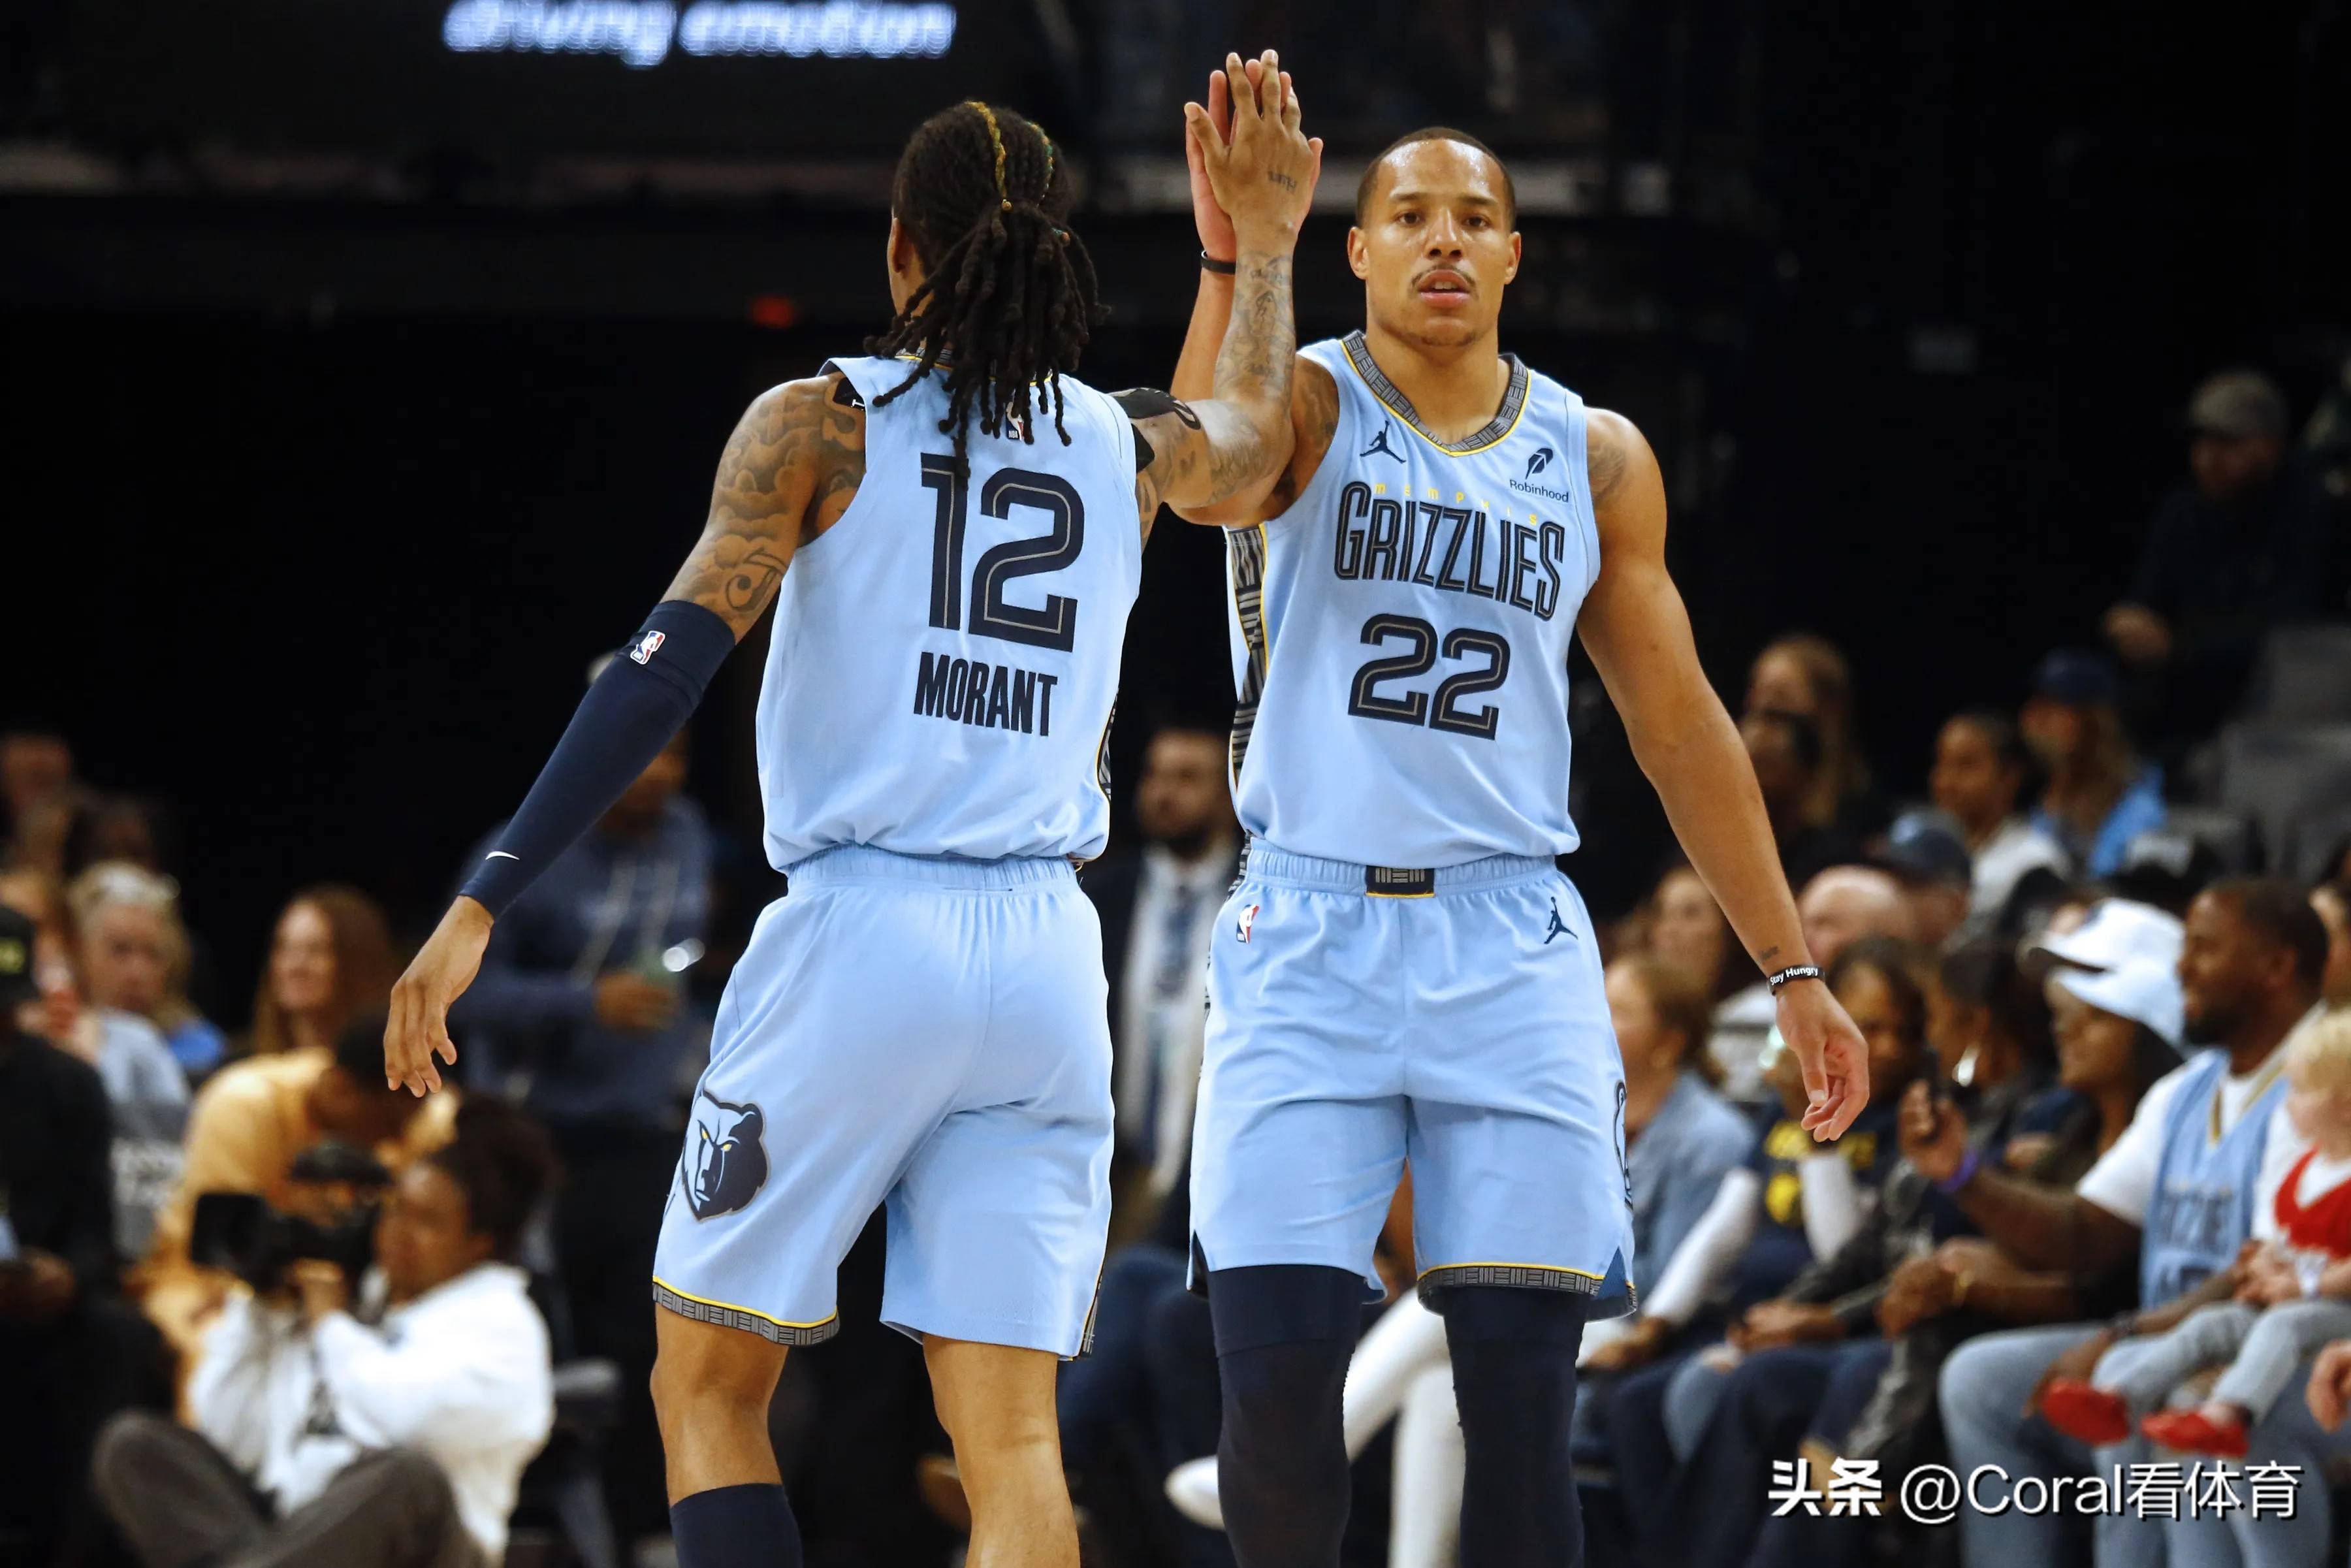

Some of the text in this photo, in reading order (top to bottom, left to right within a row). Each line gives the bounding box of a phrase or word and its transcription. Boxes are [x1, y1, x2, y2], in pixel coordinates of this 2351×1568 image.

[1509, 479, 1569, 503] Robinhood
[921, 452, 1084, 652] 12
[1334, 481, 1565, 622] GRIZZLIES
[914, 652, 1057, 736] MORANT
[1348, 613, 1511, 741] 22
[1770, 967, 1818, 985] Stay Hungry
